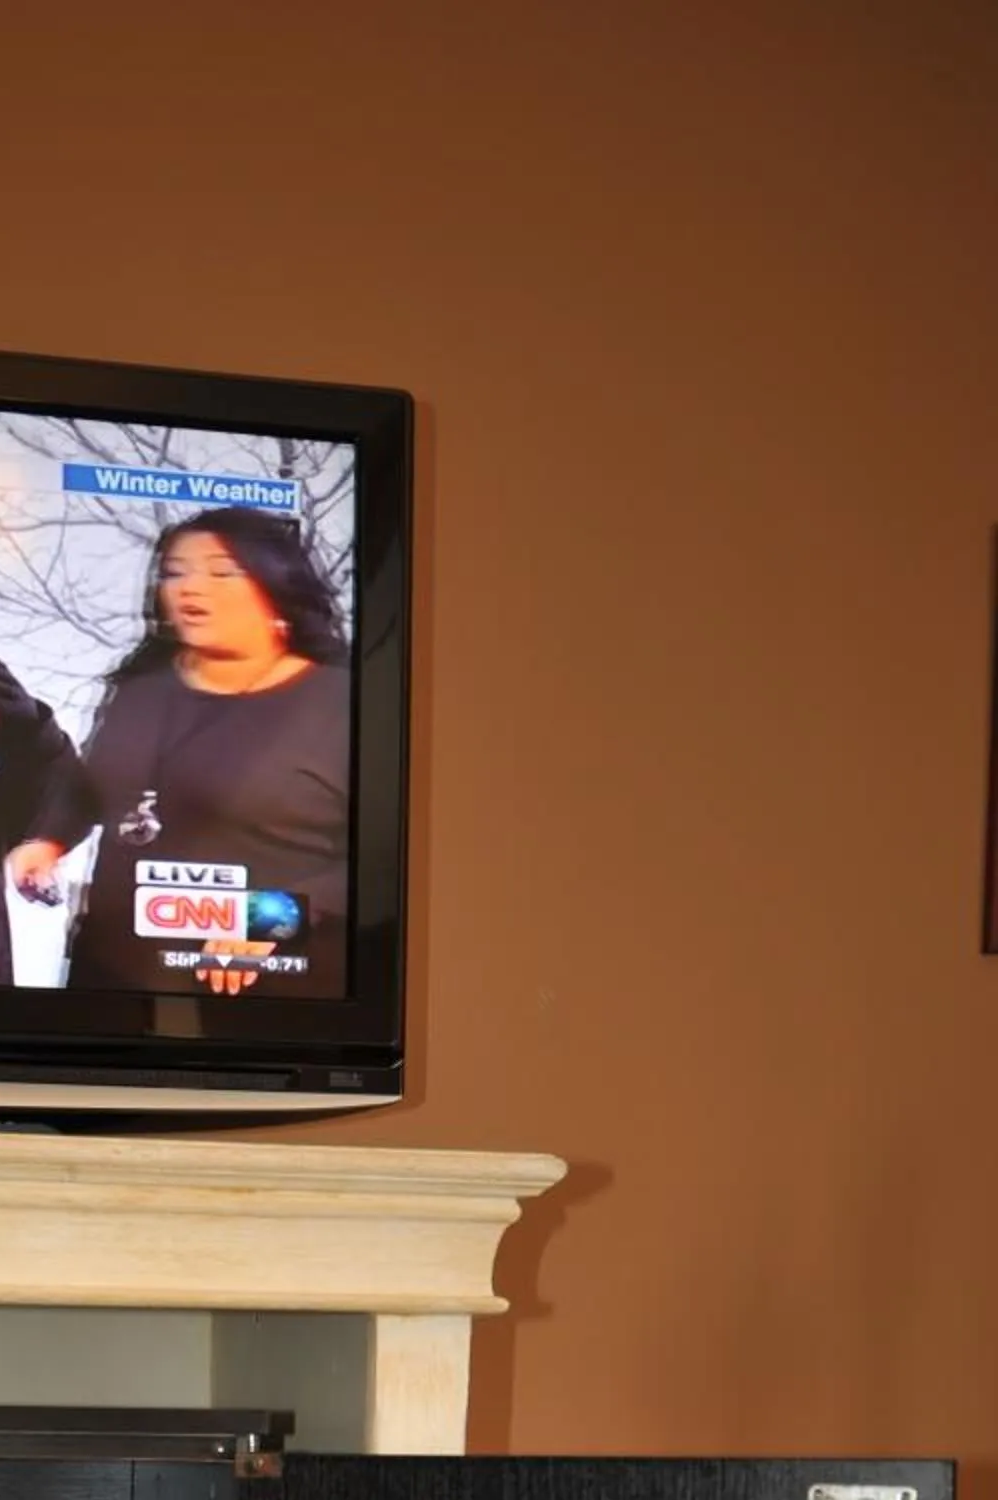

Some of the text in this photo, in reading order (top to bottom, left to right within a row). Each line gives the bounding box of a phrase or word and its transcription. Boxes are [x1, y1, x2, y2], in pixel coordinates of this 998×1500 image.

[95, 467, 294, 505] Winter Weather
[148, 865, 235, 885] LIVE
[146, 895, 236, 931] CNN
